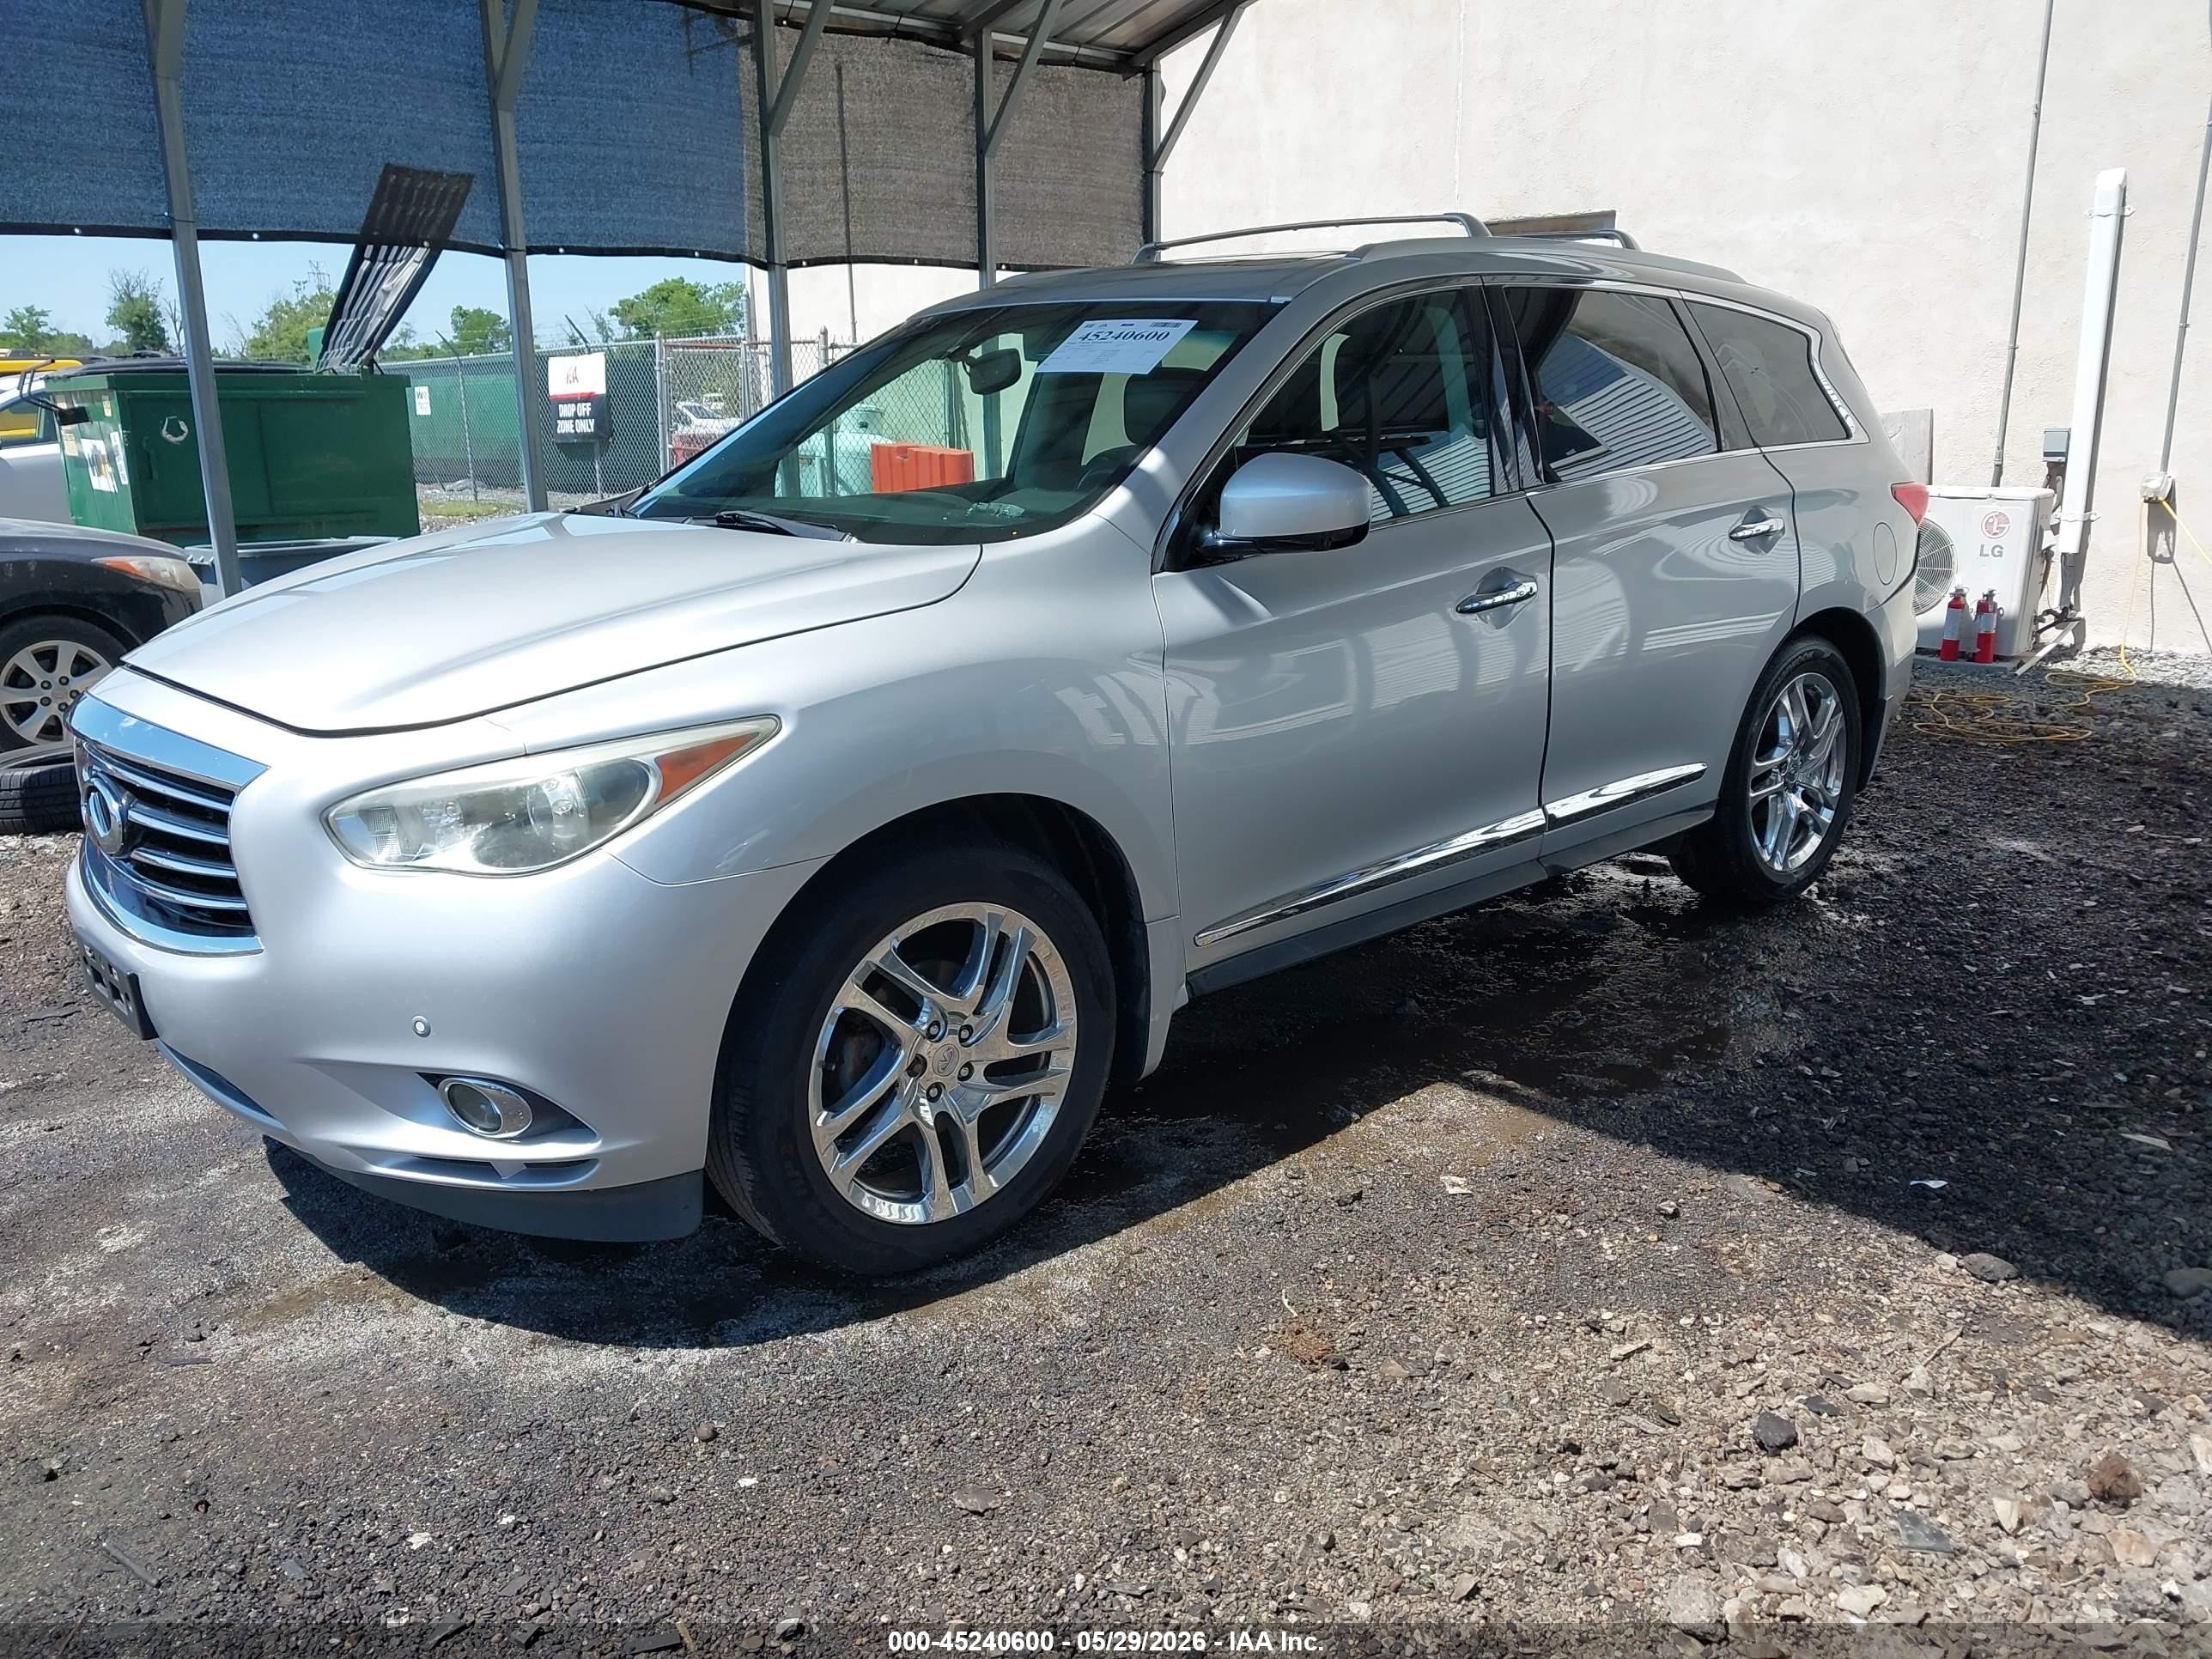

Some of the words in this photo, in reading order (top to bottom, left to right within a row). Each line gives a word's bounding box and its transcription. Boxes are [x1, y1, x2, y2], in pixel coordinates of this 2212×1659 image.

[1079, 331, 1170, 341] 45240600
[558, 403, 576, 418] DROP
[576, 402, 592, 417] OFF
[556, 419, 575, 434] ZONE
[574, 418, 595, 434] ONLY
[1979, 544, 2004, 558] LG
